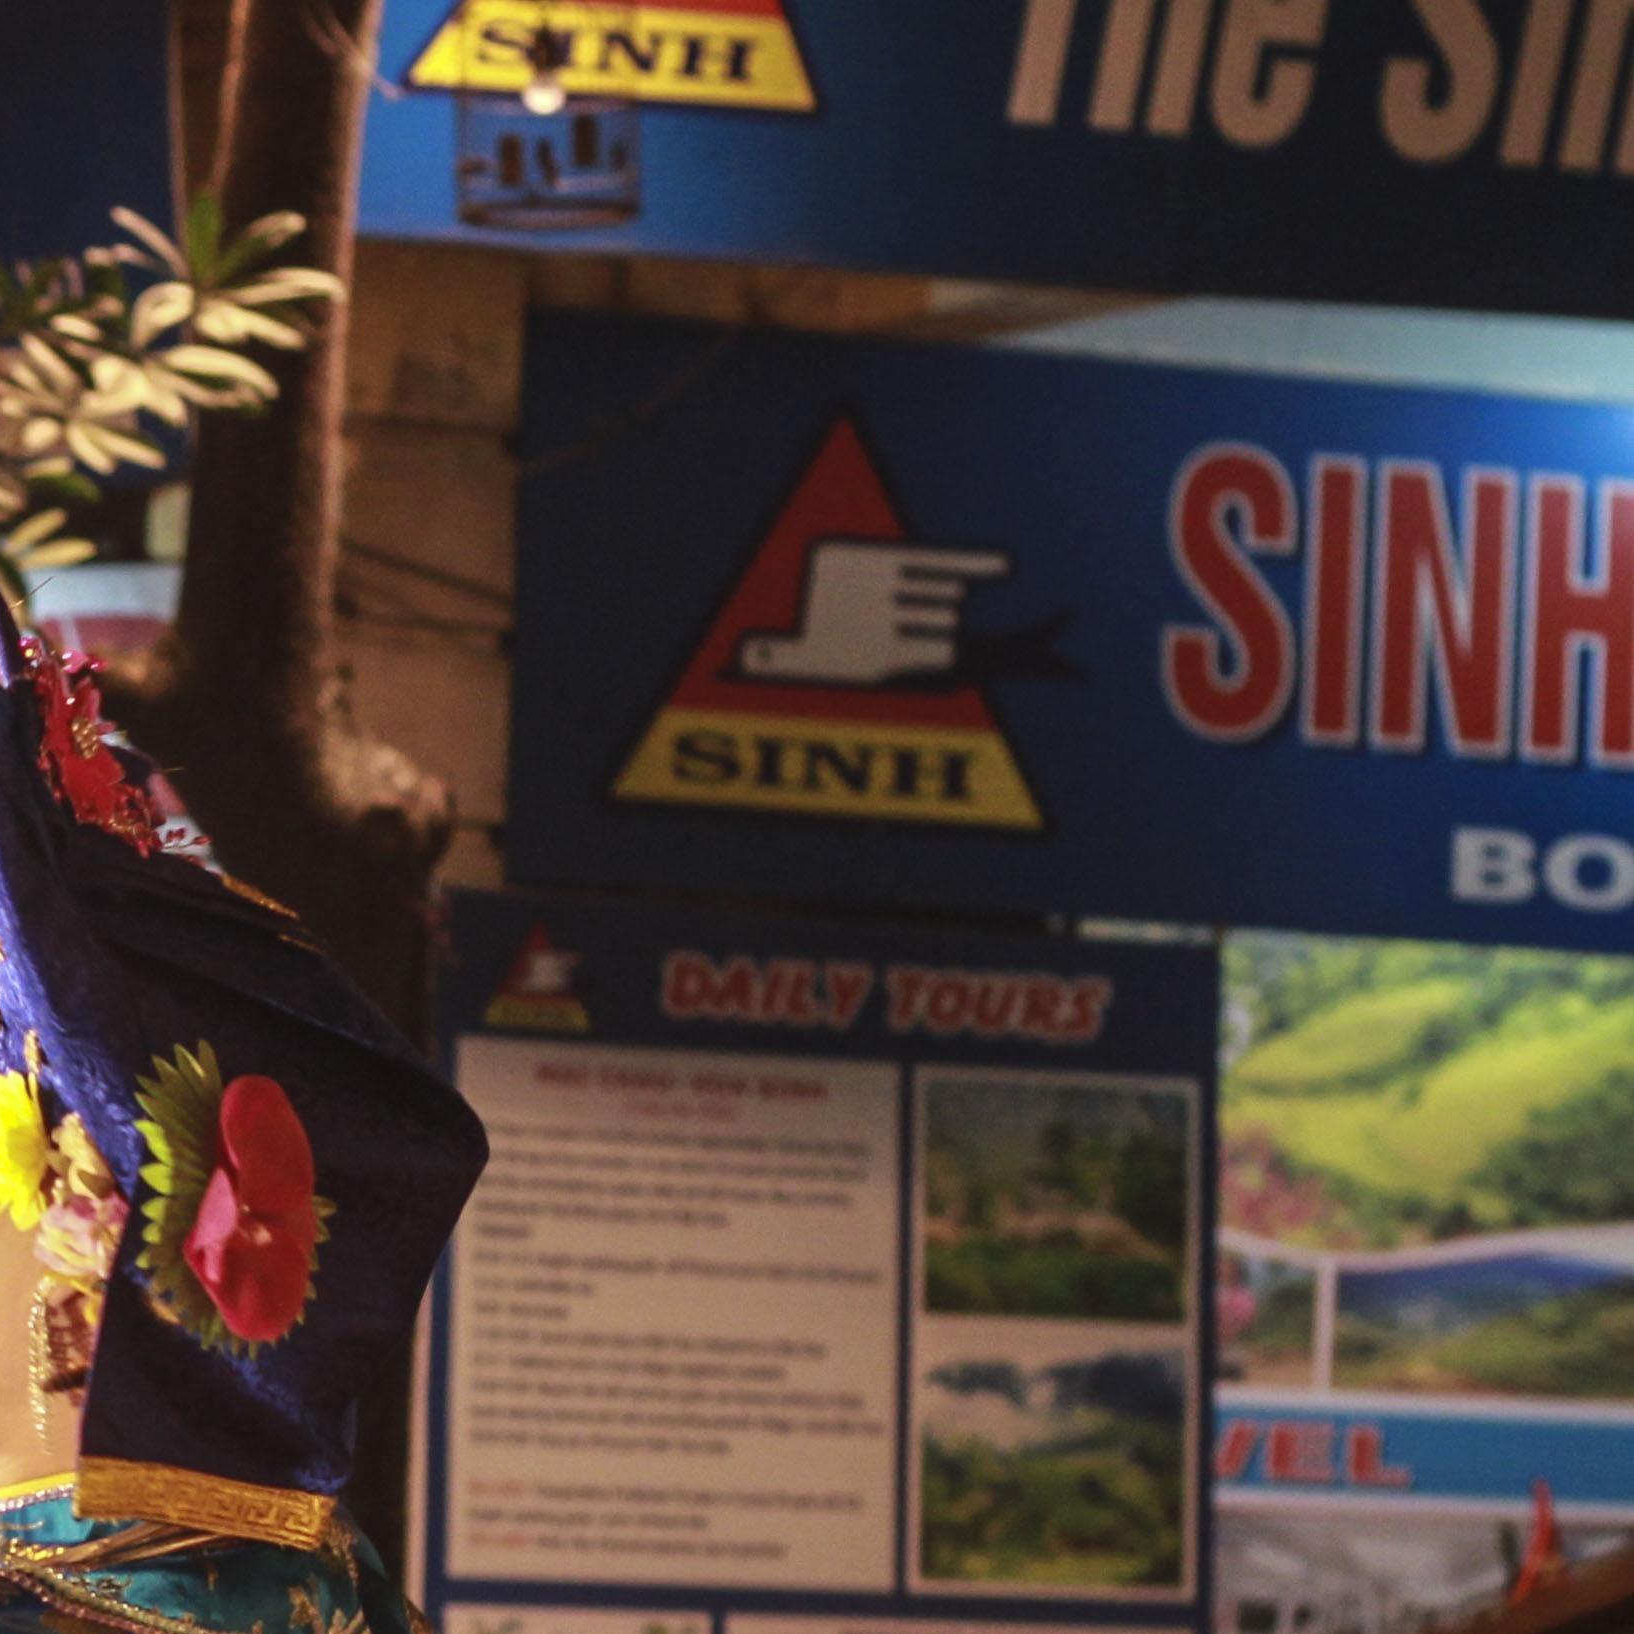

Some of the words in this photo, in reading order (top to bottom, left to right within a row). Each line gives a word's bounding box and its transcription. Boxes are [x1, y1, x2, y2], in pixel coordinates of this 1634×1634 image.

[473, 8, 763, 88] SINH
[1162, 441, 1634, 770] SINH
[671, 728, 977, 801] SINH
[660, 948, 873, 1031] DAILY
[885, 962, 1112, 1044] TOURS
